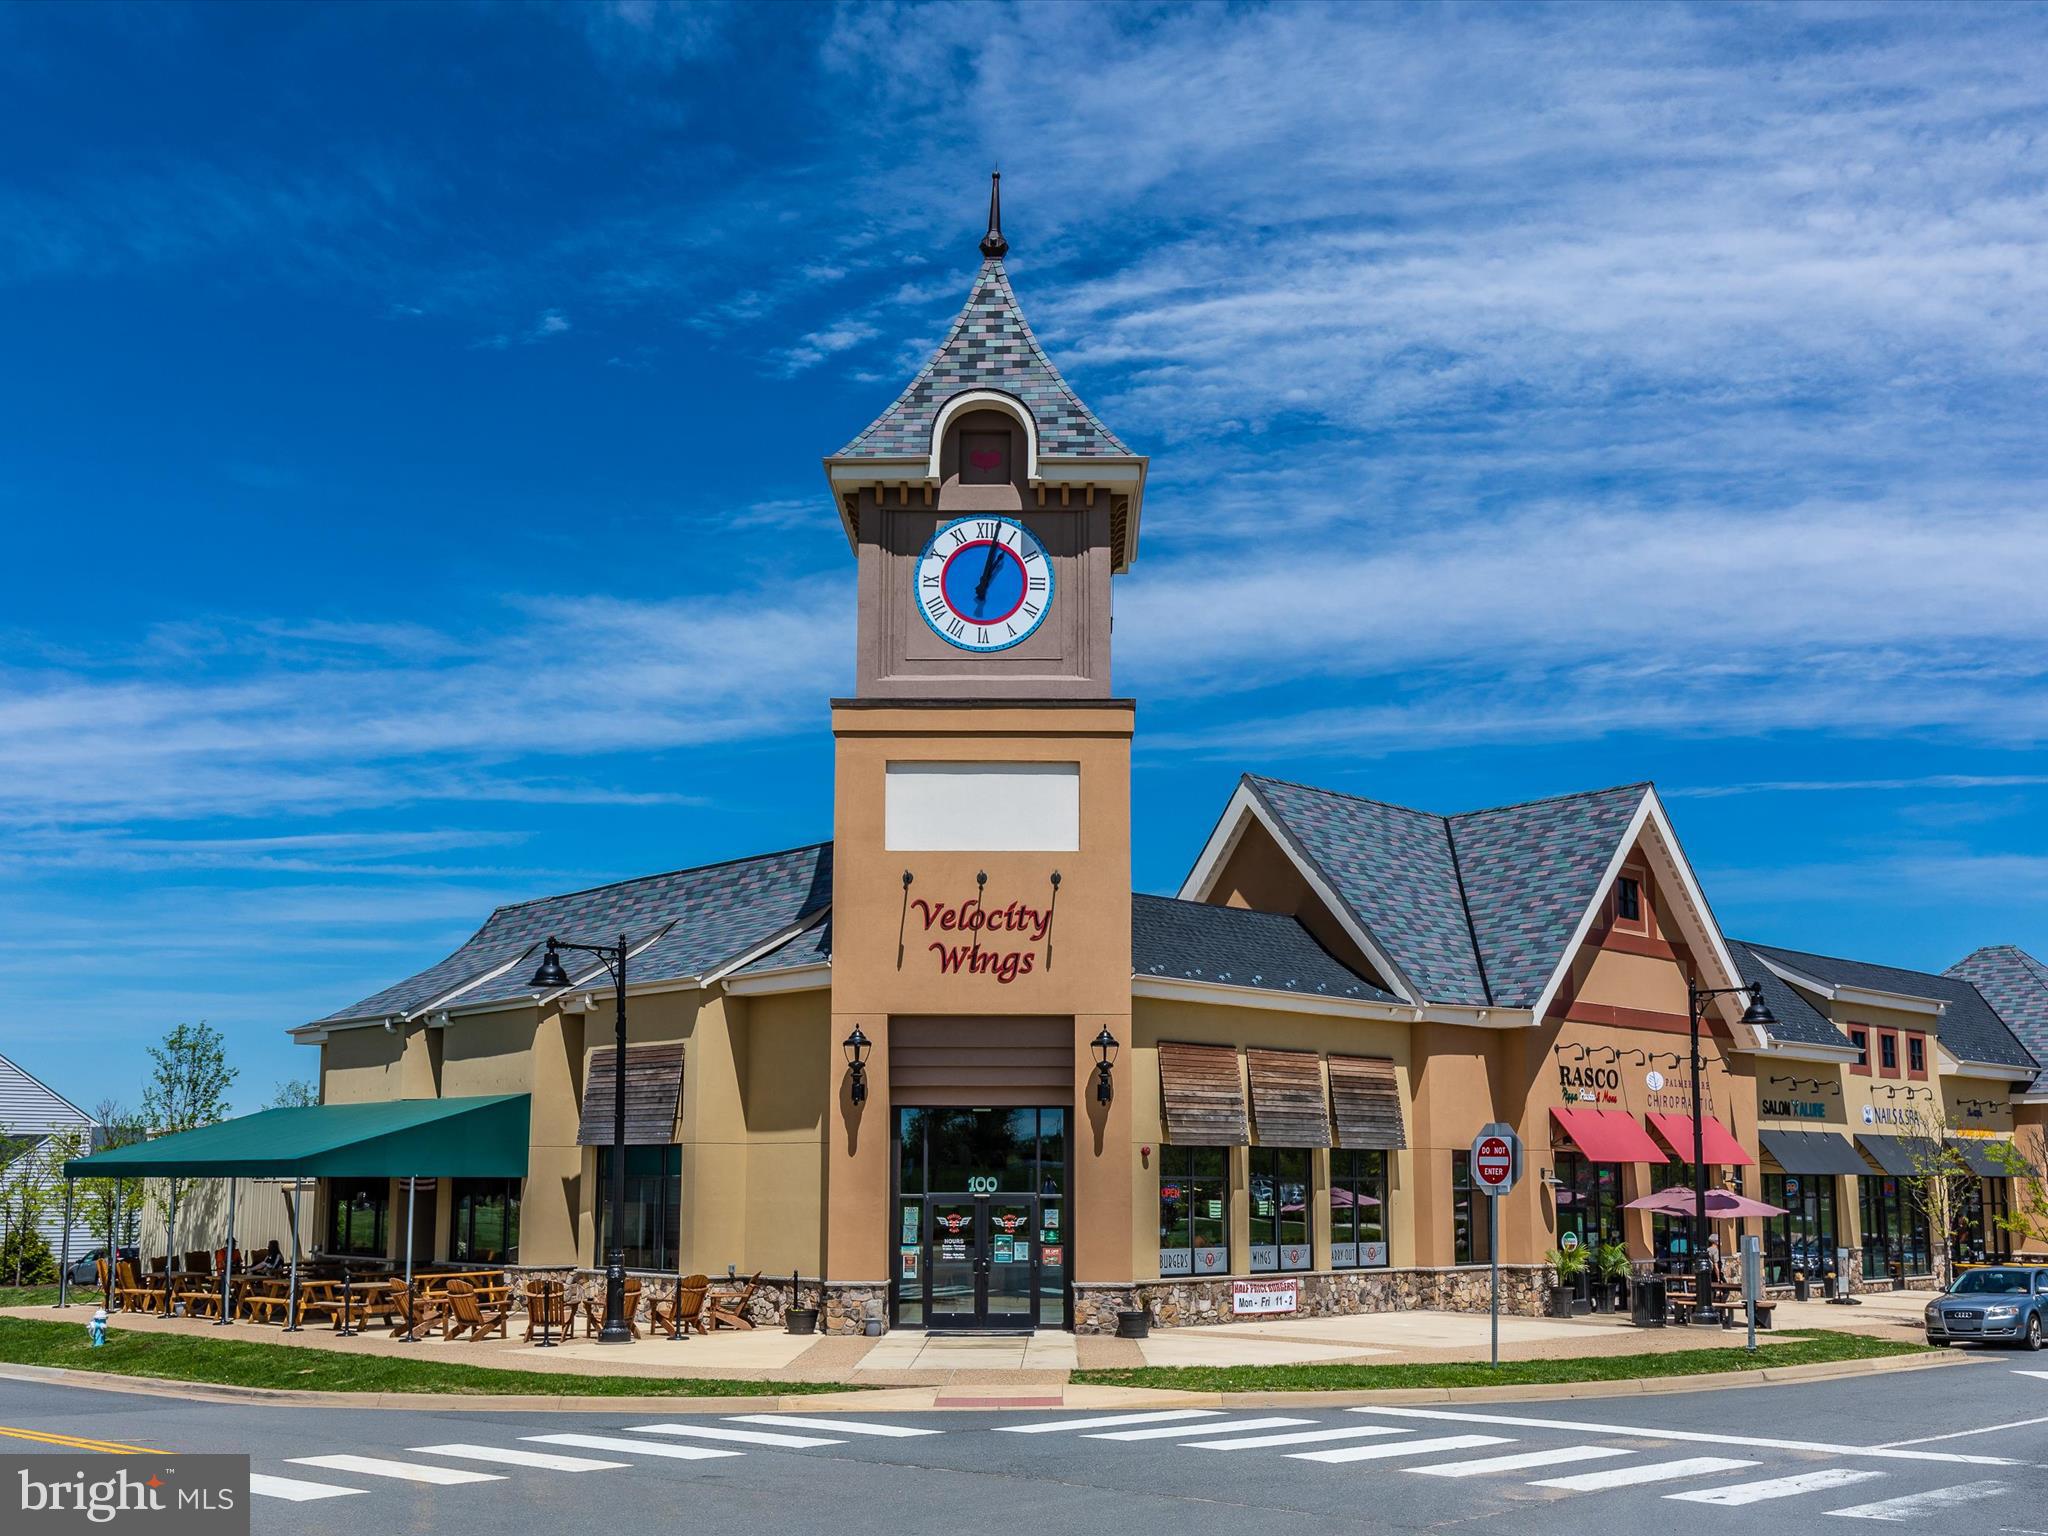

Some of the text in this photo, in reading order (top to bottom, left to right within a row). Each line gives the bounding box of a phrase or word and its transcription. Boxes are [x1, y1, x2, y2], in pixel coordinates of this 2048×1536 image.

[911, 899, 1053, 941] Velocity
[929, 942, 1035, 984] Wings
[1559, 1065, 1619, 1089] RASCO
[1647, 1094, 1713, 1111] CHIROPRATIC
[1762, 1099, 1791, 1116] SALON
[1874, 1107, 1898, 1124] NAILS
[1898, 1109, 1904, 1125] &
[968, 1176, 998, 1192] 100
[1161, 1187, 1181, 1198] OPEN
[1160, 1254, 1188, 1268] BURGERS
[1252, 1251, 1271, 1265] WINGS
[1344, 1248, 1355, 1260] OUT
[1235, 1284, 1249, 1293] HALF
[1250, 1283, 1268, 1293] PRICE
[1239, 1298, 1253, 1308] Mon
[1261, 1297, 1271, 1307] Fri
[1276, 1296, 1283, 1305] 11
[1289, 1295, 1293, 1305] 2
